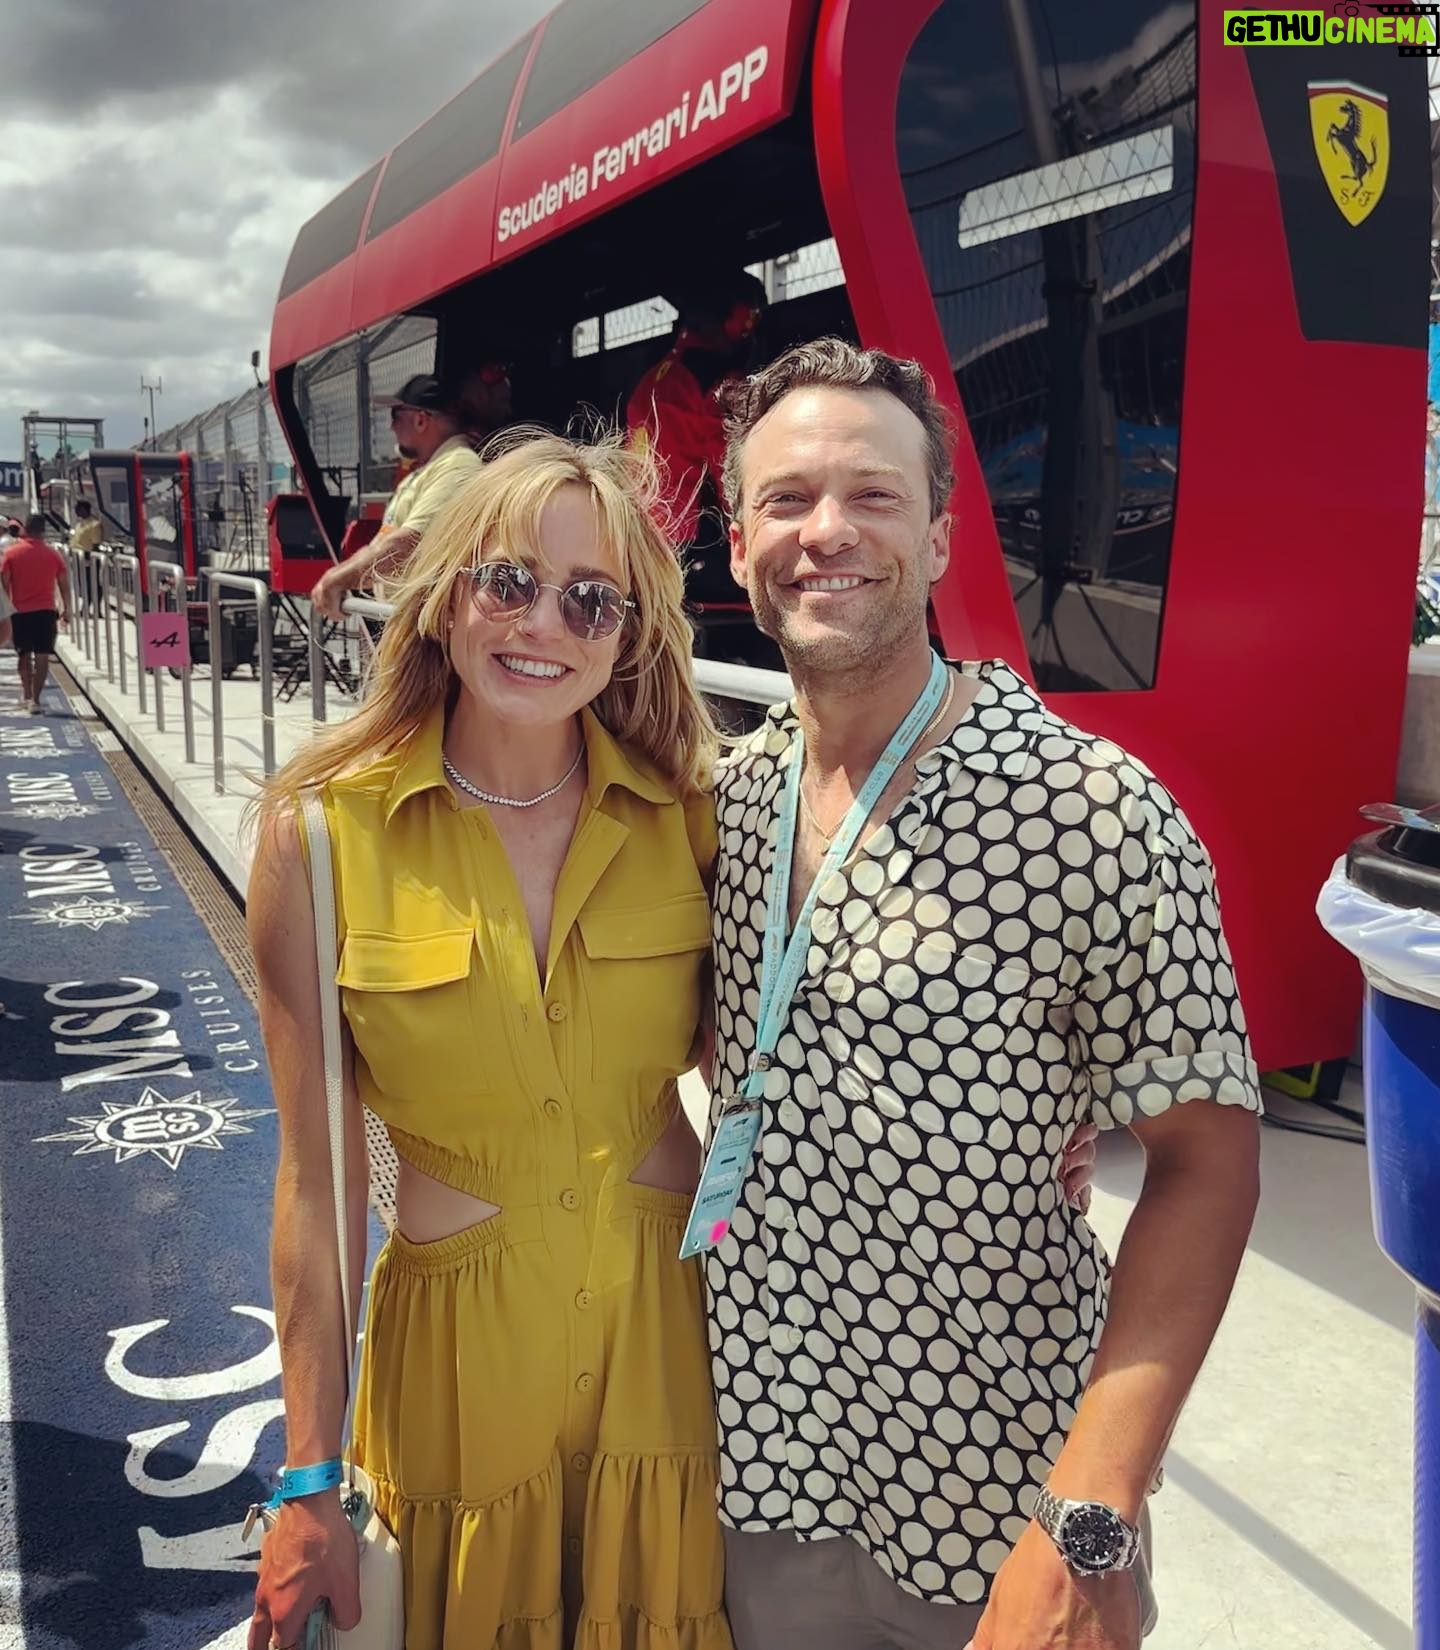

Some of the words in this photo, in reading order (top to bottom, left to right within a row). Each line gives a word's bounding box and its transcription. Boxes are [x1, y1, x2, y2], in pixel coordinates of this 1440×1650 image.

[498, 163, 588, 242] Scuderia
[592, 91, 690, 191] Ferrari
[691, 45, 768, 132] APP
[6, 772, 78, 803] MSC
[19, 844, 116, 898] MSC
[44, 976, 194, 1092] MSC
[181, 969, 259, 1073] CRUISES
